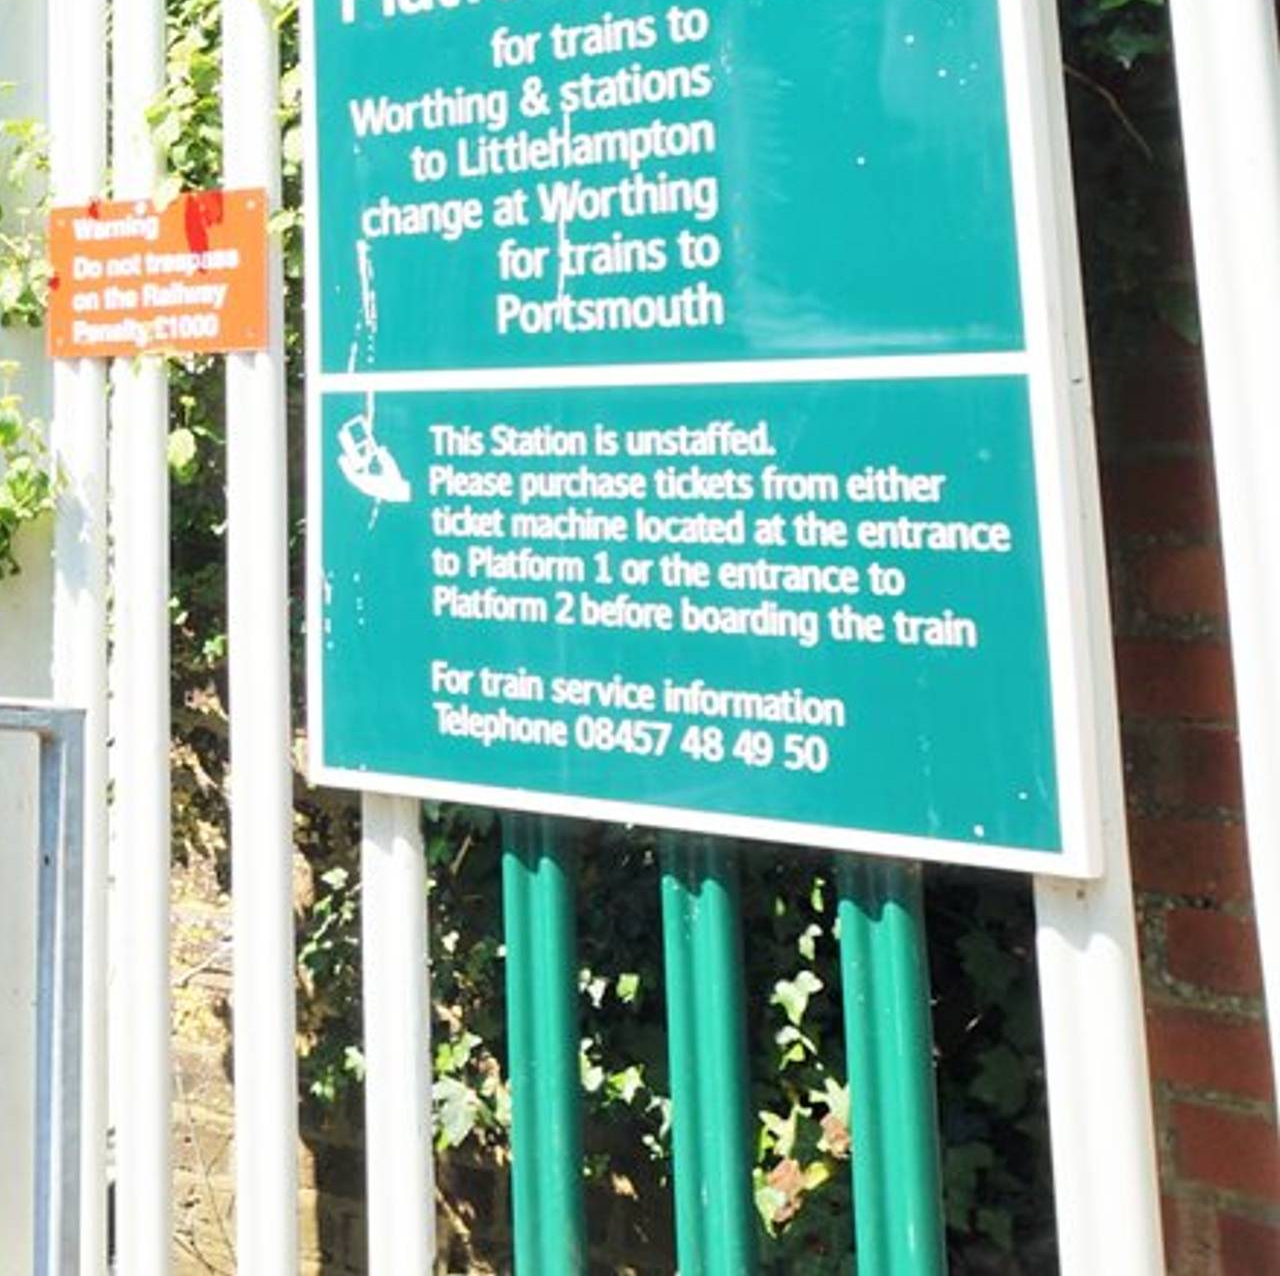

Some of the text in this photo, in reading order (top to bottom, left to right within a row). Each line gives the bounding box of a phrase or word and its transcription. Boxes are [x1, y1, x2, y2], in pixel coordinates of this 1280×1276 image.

[491, 6, 709, 67] for trains to
[349, 63, 711, 138] Worthing & stations
[410, 118, 715, 182] to Littlehampton
[73, 215, 159, 240] Warning
[362, 174, 718, 245] change at Worthing
[73, 257, 103, 278] Do
[107, 255, 141, 277] not
[498, 230, 720, 280] for trains to
[73, 283, 227, 310] on the Railway
[497, 285, 724, 334] Portsmouth
[429, 420, 776, 456] This Station is unstaffed.
[428, 464, 945, 505] Please purchase tickets from either
[431, 505, 1011, 551] ticket machine located at the entrance
[432, 545, 905, 596] to Platform 1 or the entrance to
[433, 585, 977, 647] Platform 2 before boarding the train
[432, 660, 845, 726] For train service information
[433, 701, 828, 772] Telephone 08457 48 49 50
